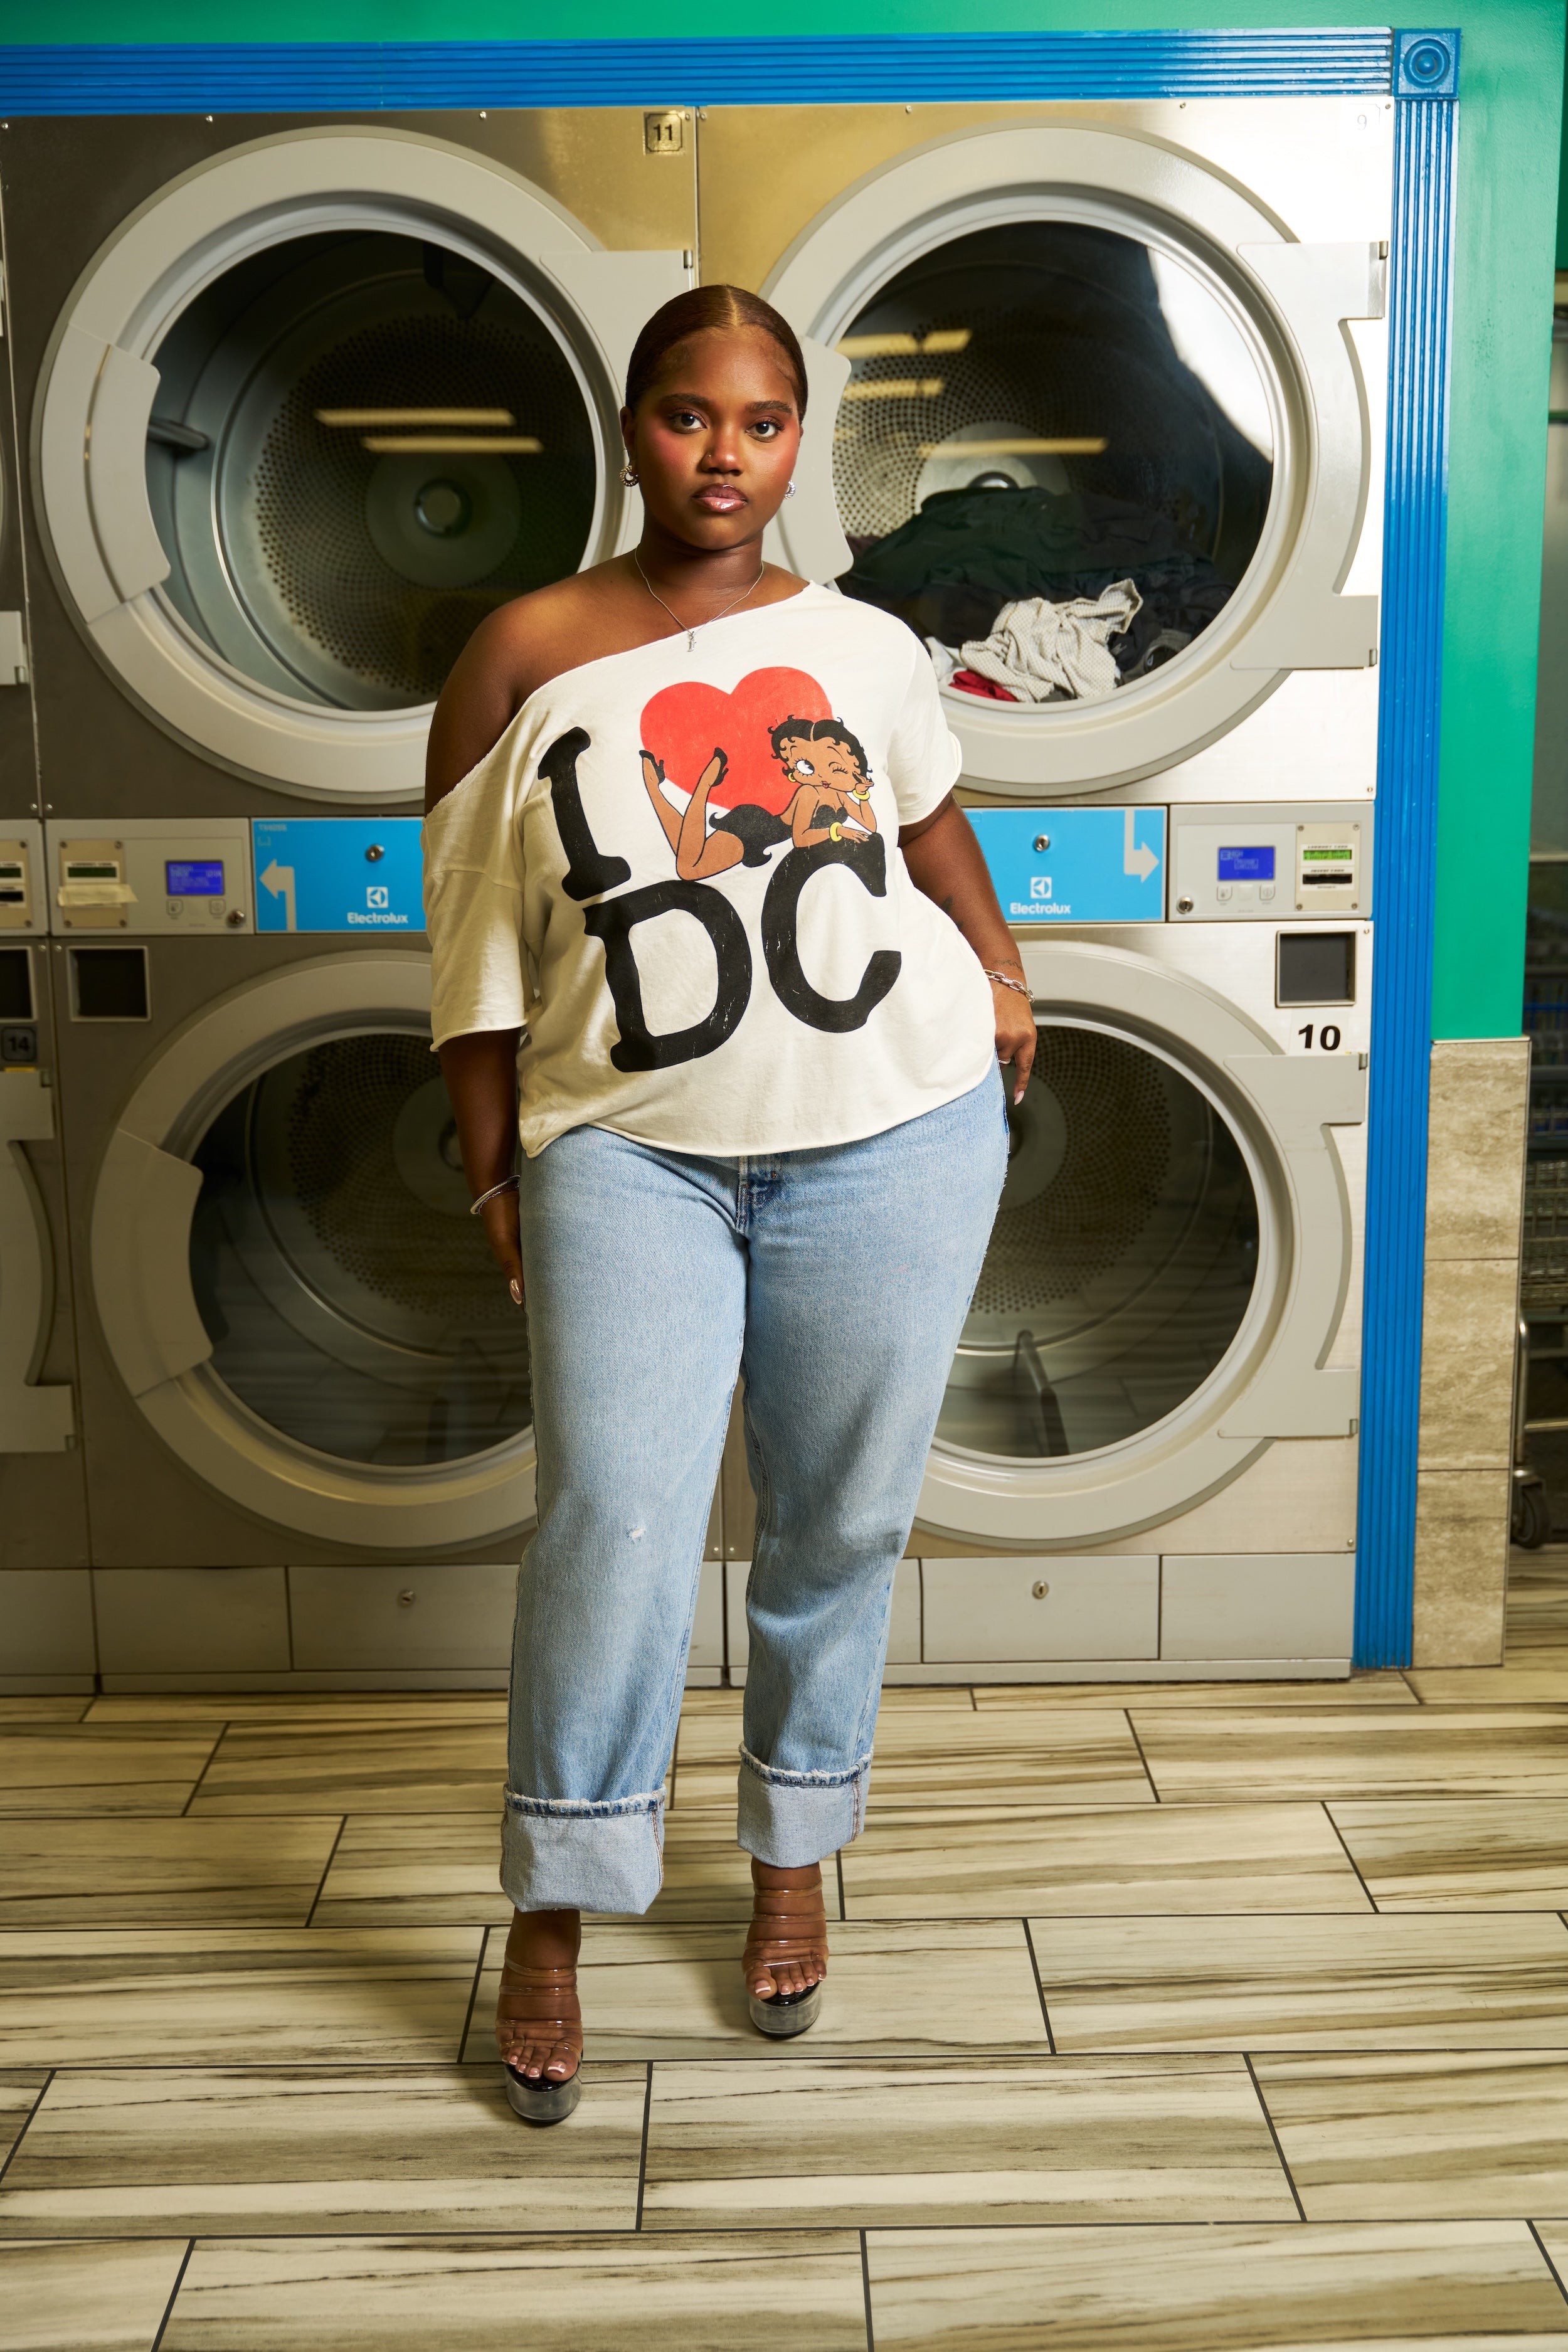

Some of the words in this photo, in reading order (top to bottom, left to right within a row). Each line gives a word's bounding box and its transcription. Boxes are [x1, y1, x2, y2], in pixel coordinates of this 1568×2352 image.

[1357, 114, 1367, 130] 9
[653, 124, 672, 141] 11
[538, 726, 631, 901] I
[1010, 902, 1071, 914] Electrolux
[347, 911, 408, 924] Electrolux
[583, 832, 902, 1073] DC
[9, 1036, 29, 1052] 14
[1298, 1024, 1341, 1051] 10
